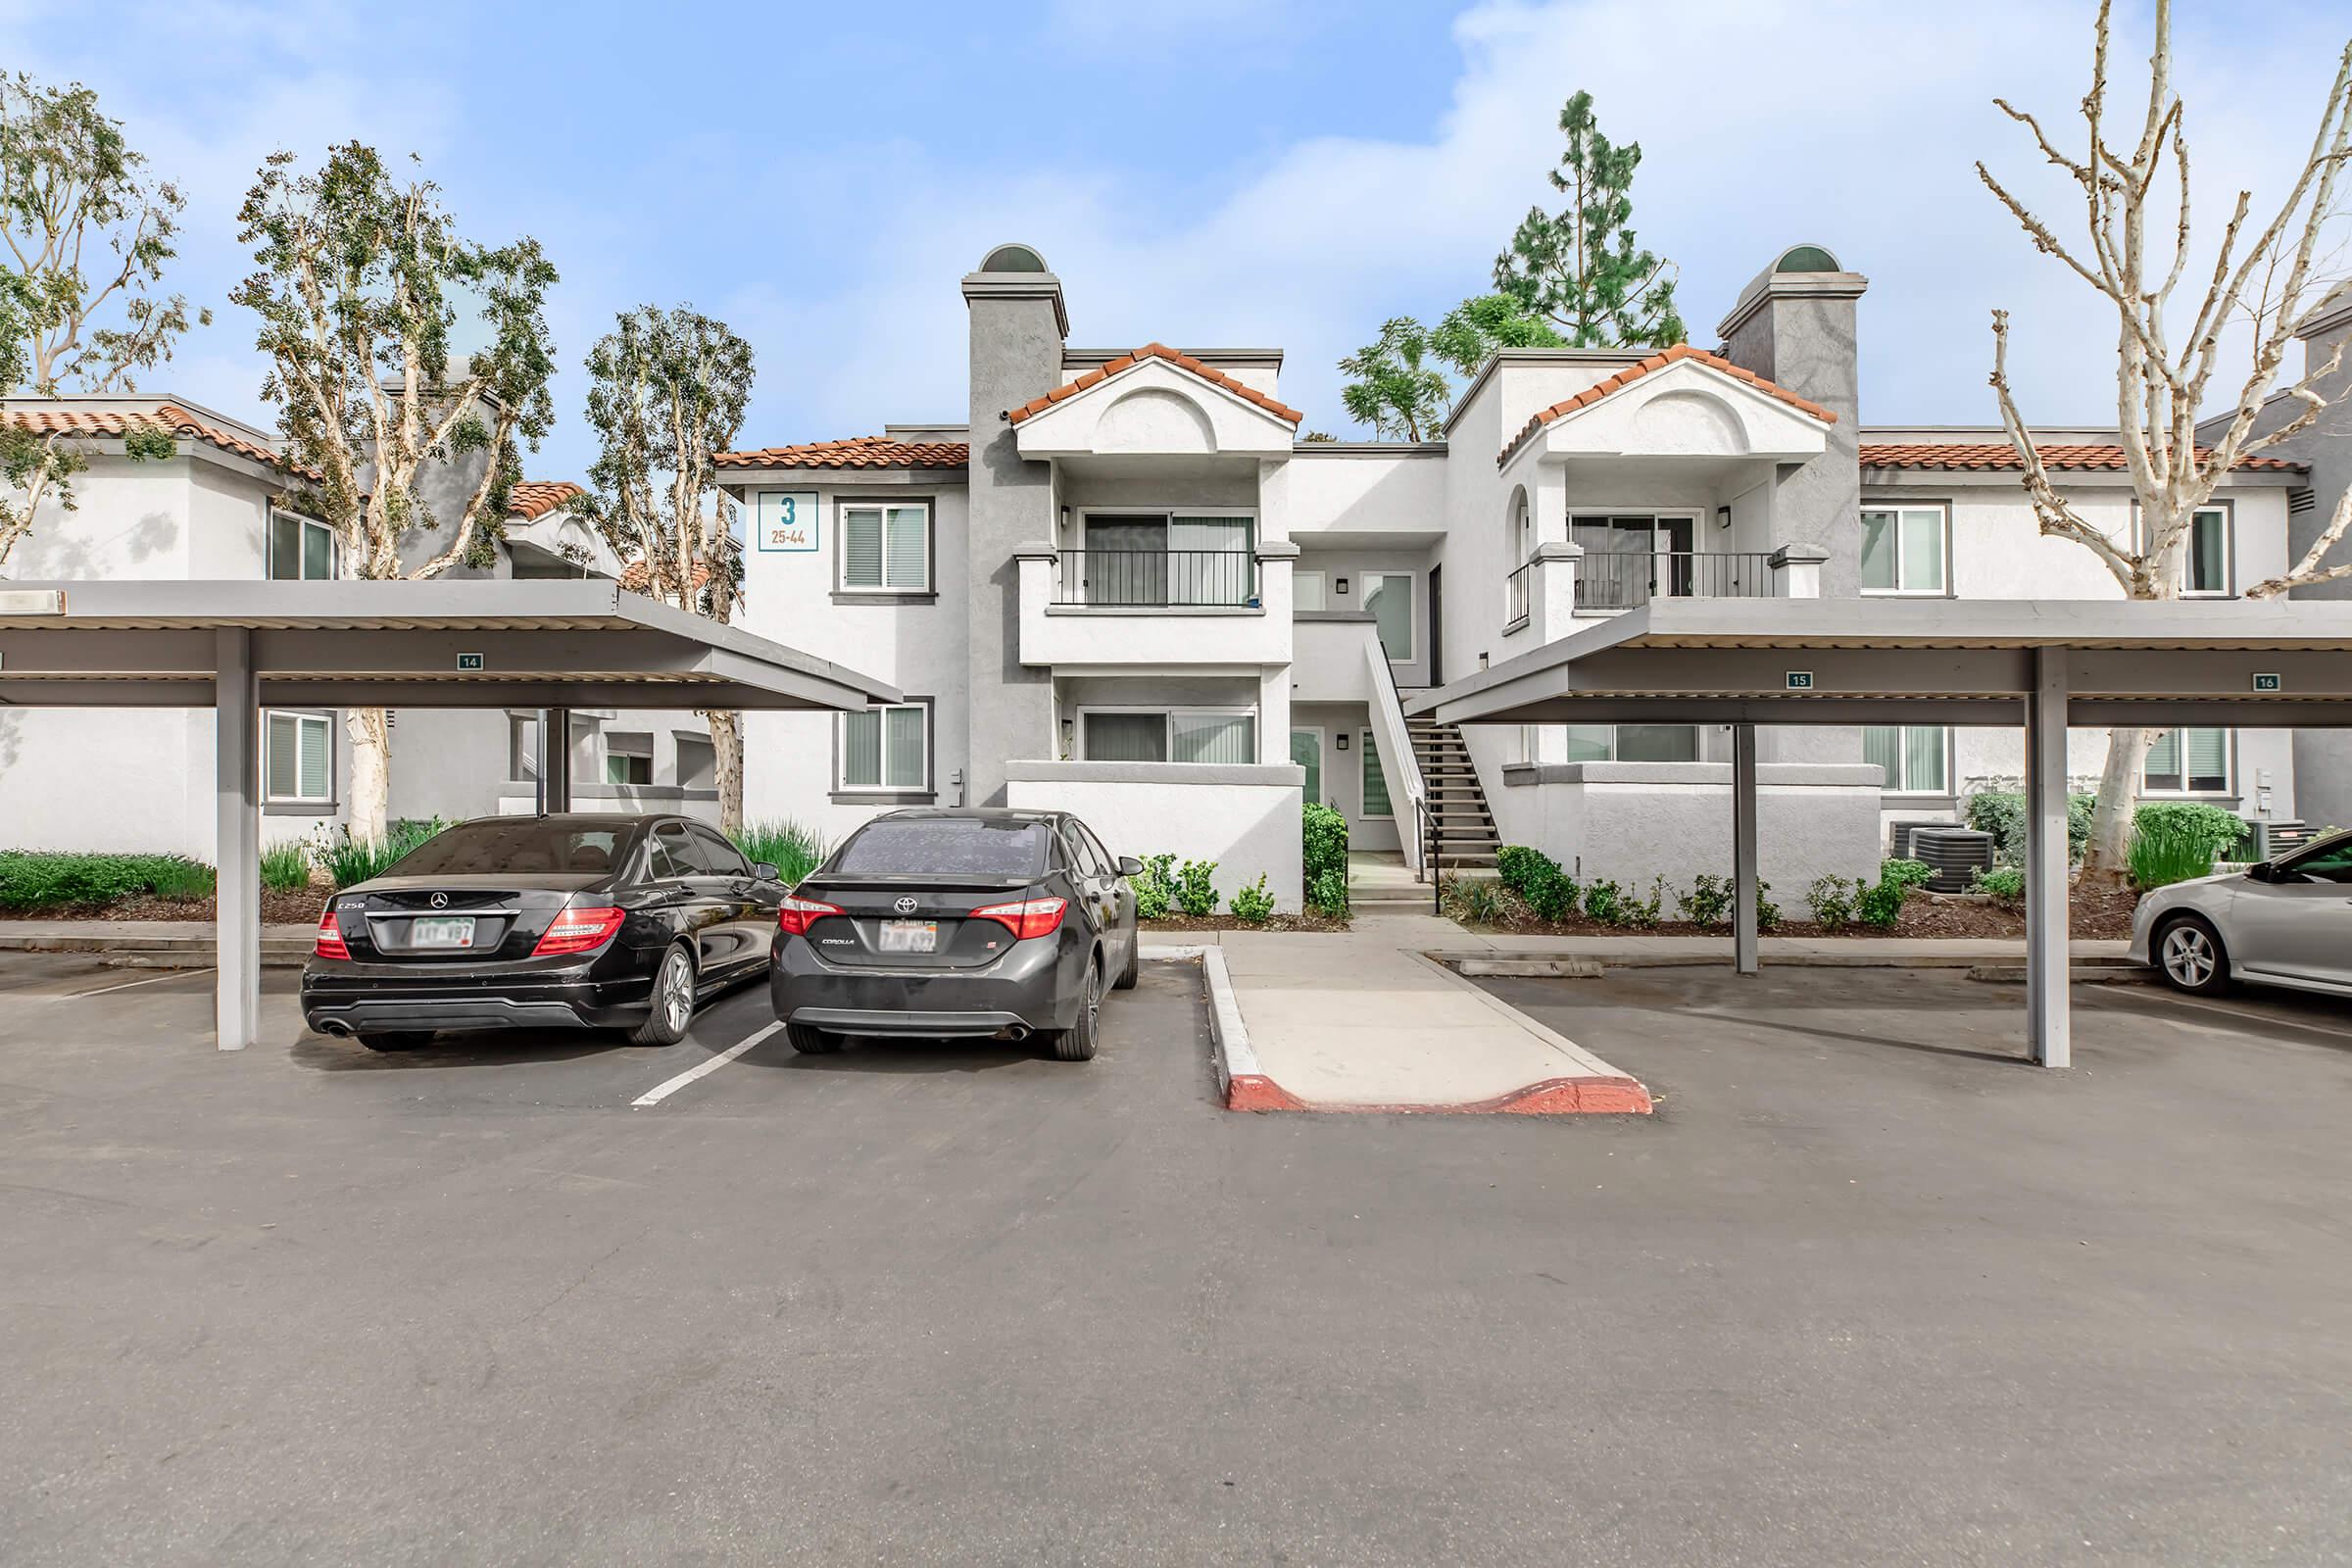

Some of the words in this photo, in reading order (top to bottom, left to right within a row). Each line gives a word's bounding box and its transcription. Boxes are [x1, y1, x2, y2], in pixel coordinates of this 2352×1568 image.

[781, 497, 796, 525] 3
[771, 530, 806, 544] 25-44
[464, 658, 478, 667] 14
[1792, 675, 1807, 686] 15
[2260, 677, 2275, 688] 16
